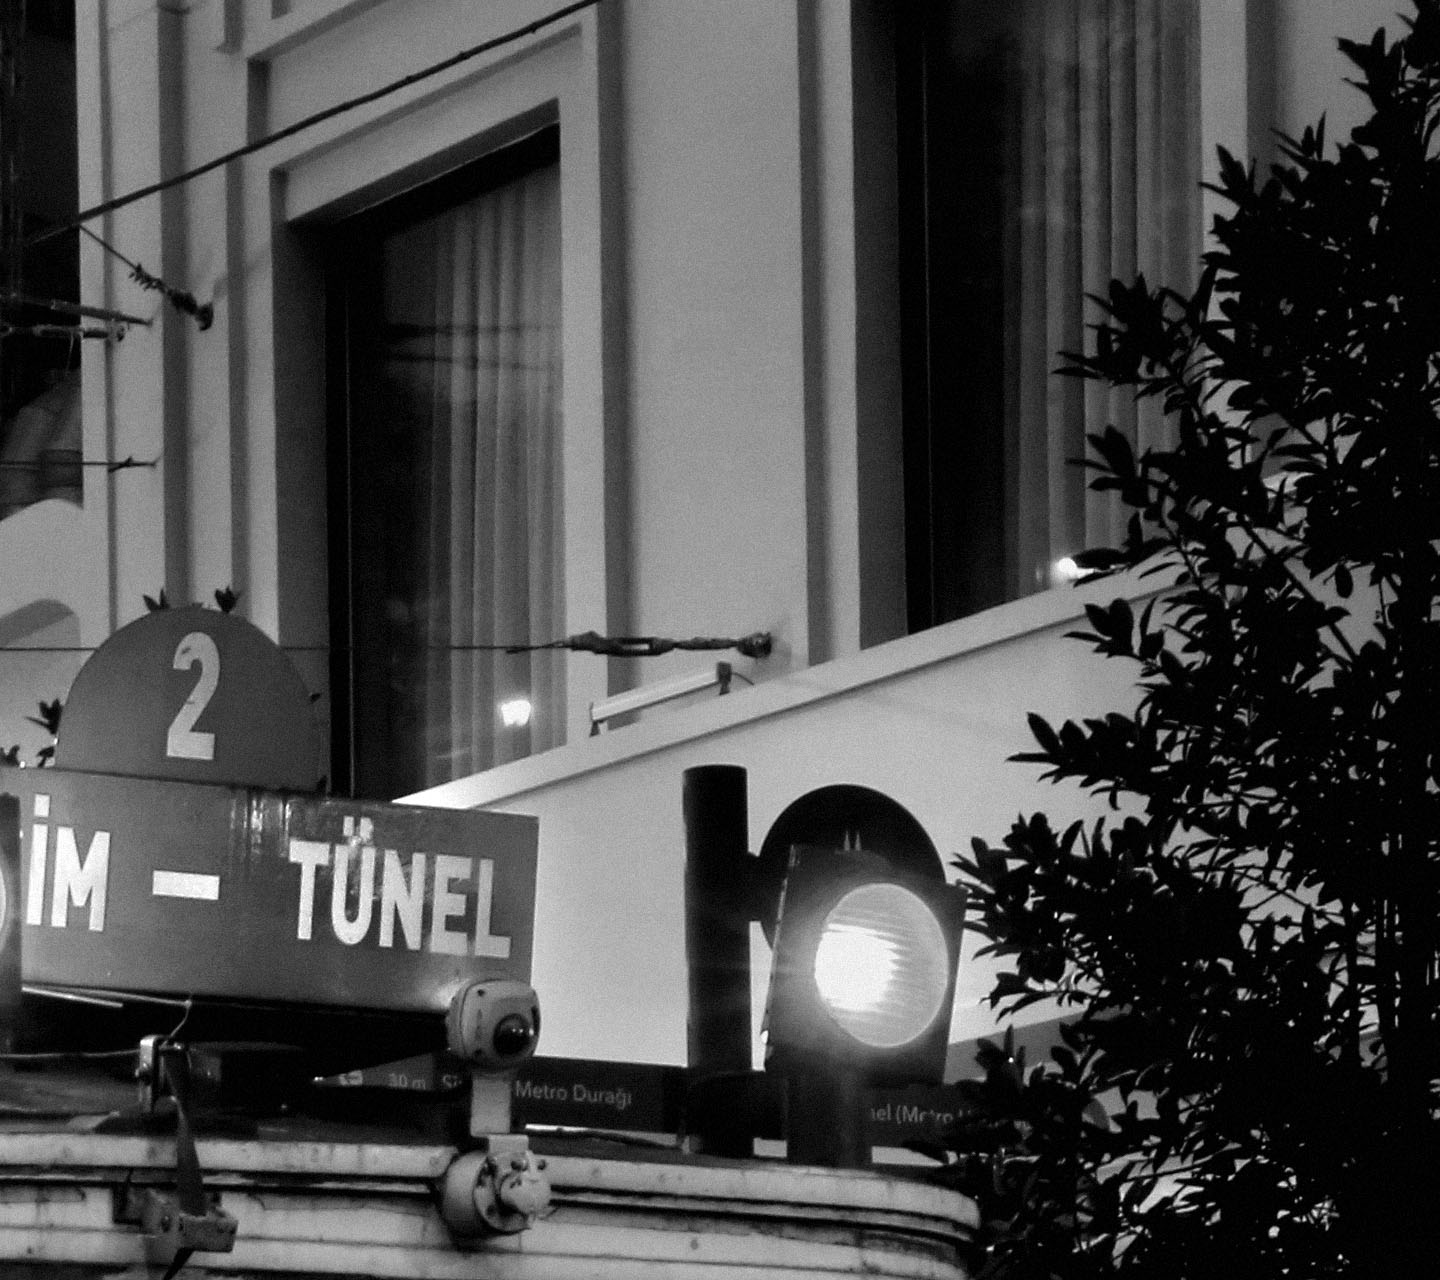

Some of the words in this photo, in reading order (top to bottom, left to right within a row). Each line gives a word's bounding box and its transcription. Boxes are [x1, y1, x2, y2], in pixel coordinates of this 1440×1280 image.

[166, 631, 221, 761] 2
[24, 793, 111, 933] İM
[288, 814, 512, 959] TÜNEL
[515, 1078, 568, 1102] Metro
[572, 1083, 632, 1111] Durağı
